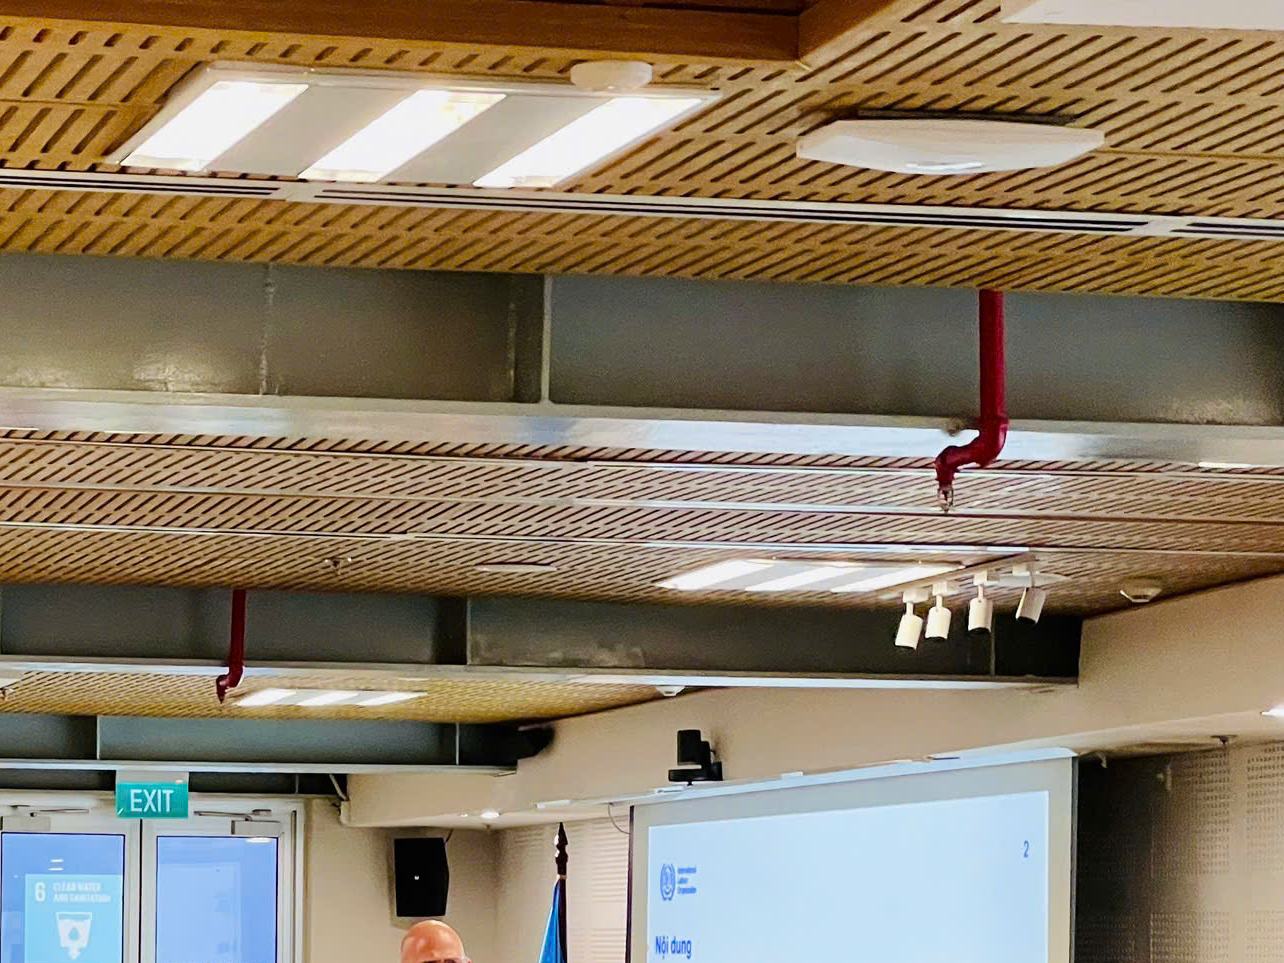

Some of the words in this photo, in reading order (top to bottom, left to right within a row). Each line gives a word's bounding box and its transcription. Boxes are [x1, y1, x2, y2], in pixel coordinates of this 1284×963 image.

[130, 788, 174, 814] EXIT
[1023, 841, 1030, 859] 2
[35, 882, 45, 902] 6
[655, 936, 669, 960] Nội
[671, 936, 692, 960] dung
